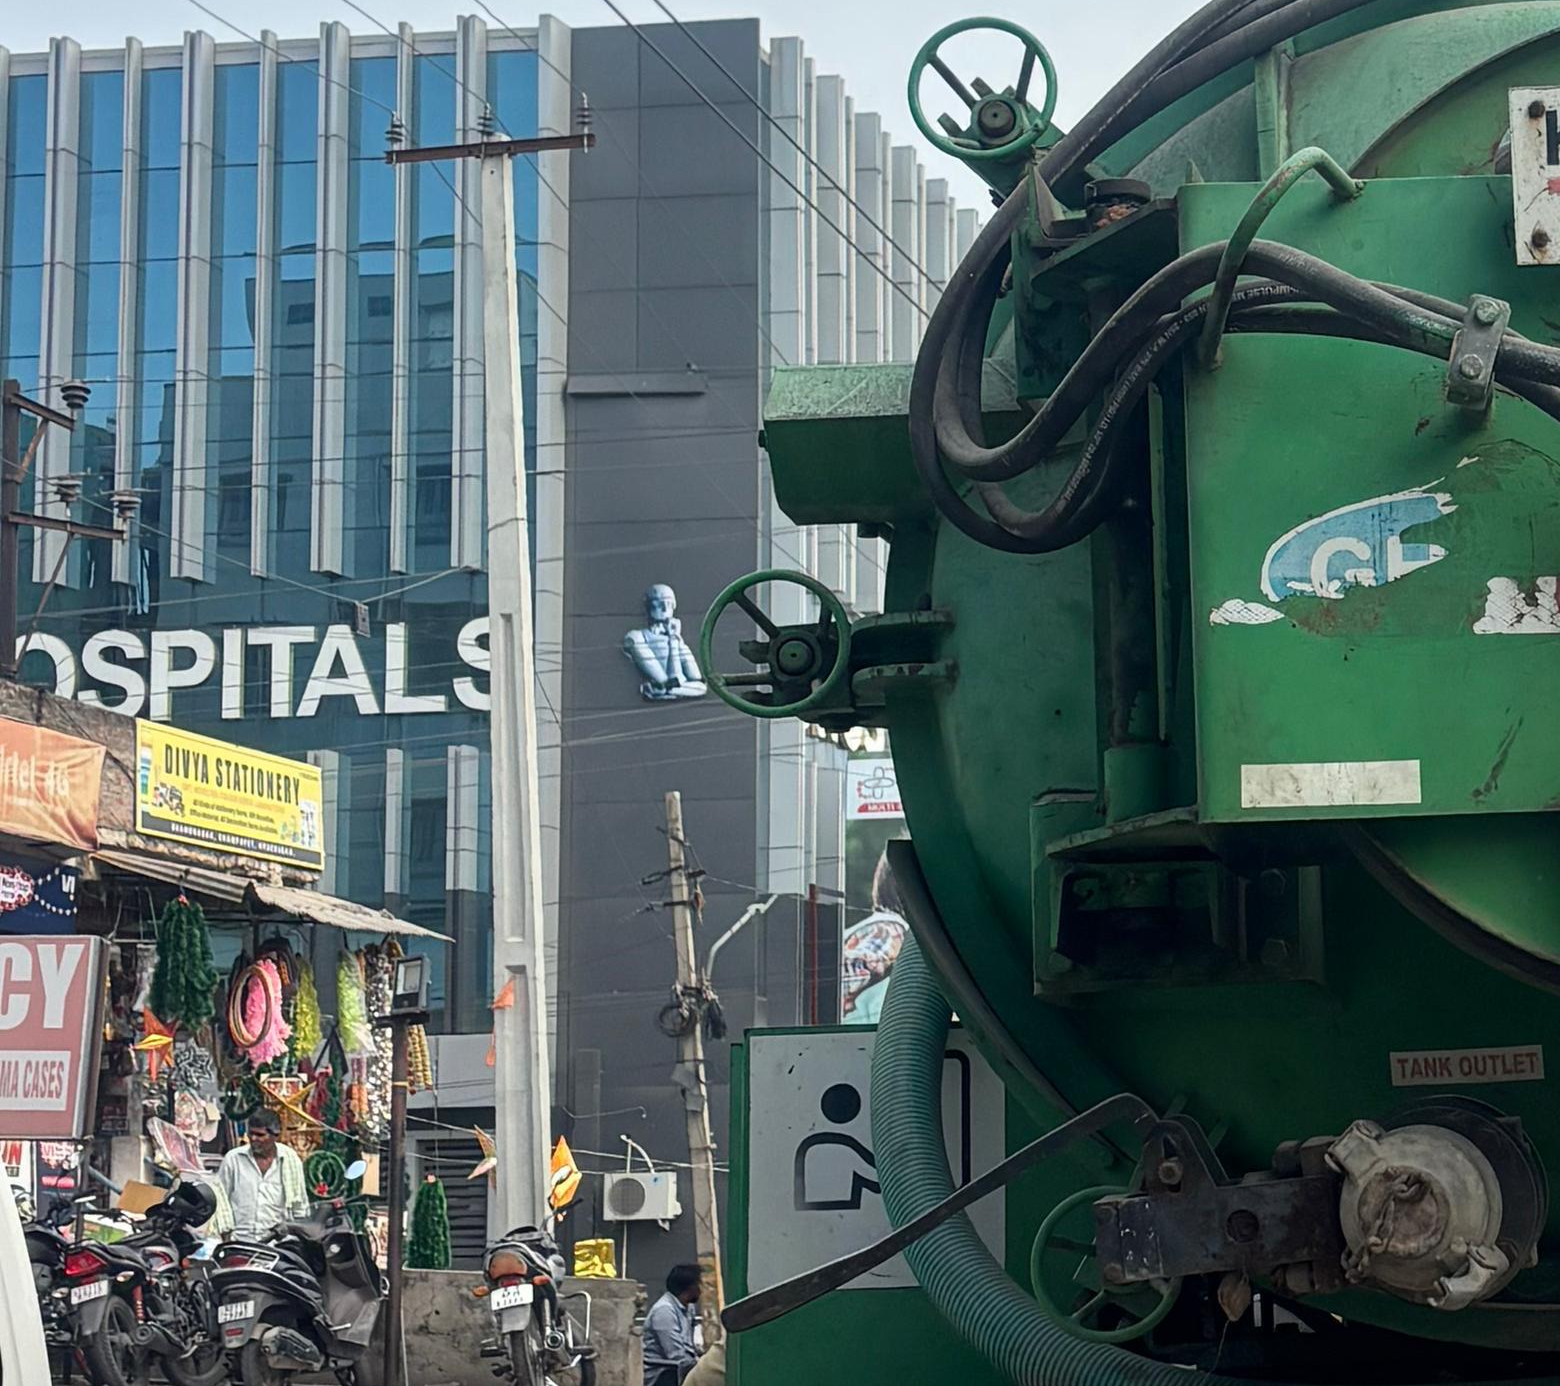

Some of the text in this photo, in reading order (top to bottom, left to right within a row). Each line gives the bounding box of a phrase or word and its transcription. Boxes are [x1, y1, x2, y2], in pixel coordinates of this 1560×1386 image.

[164, 743, 209, 785] DIVYA
[215, 757, 301, 806] STATIONERY
[0, 941, 85, 1031] CY
[23, 1060, 65, 1099] CASES
[1397, 1051, 1541, 1080] TANK OUTLET
